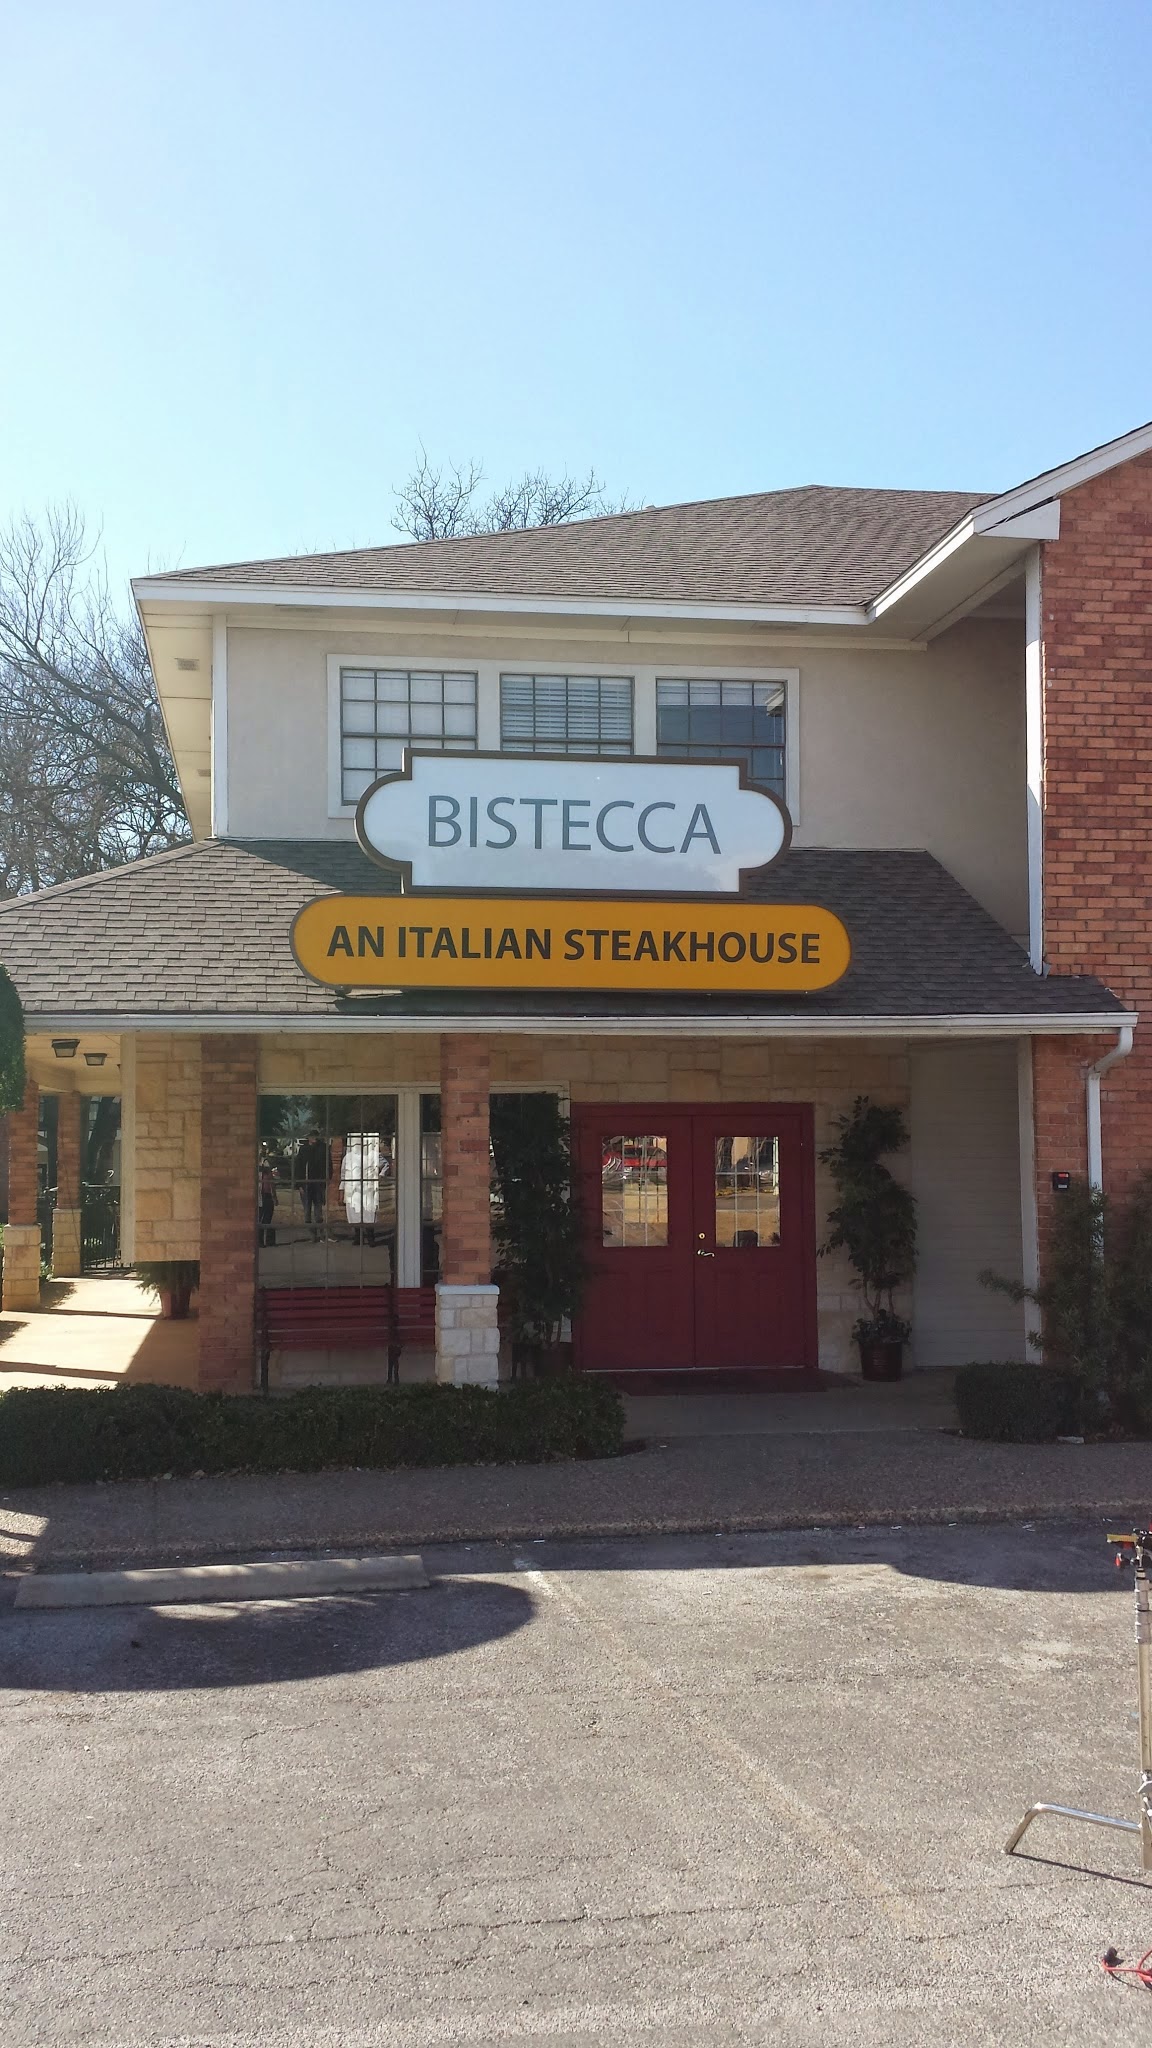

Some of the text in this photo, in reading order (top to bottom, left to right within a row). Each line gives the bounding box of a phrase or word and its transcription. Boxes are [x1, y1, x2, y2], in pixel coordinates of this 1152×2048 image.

[427, 795, 721, 855] BISTECCA
[327, 925, 820, 964] AN ITALIAN STEAKHOUSE
